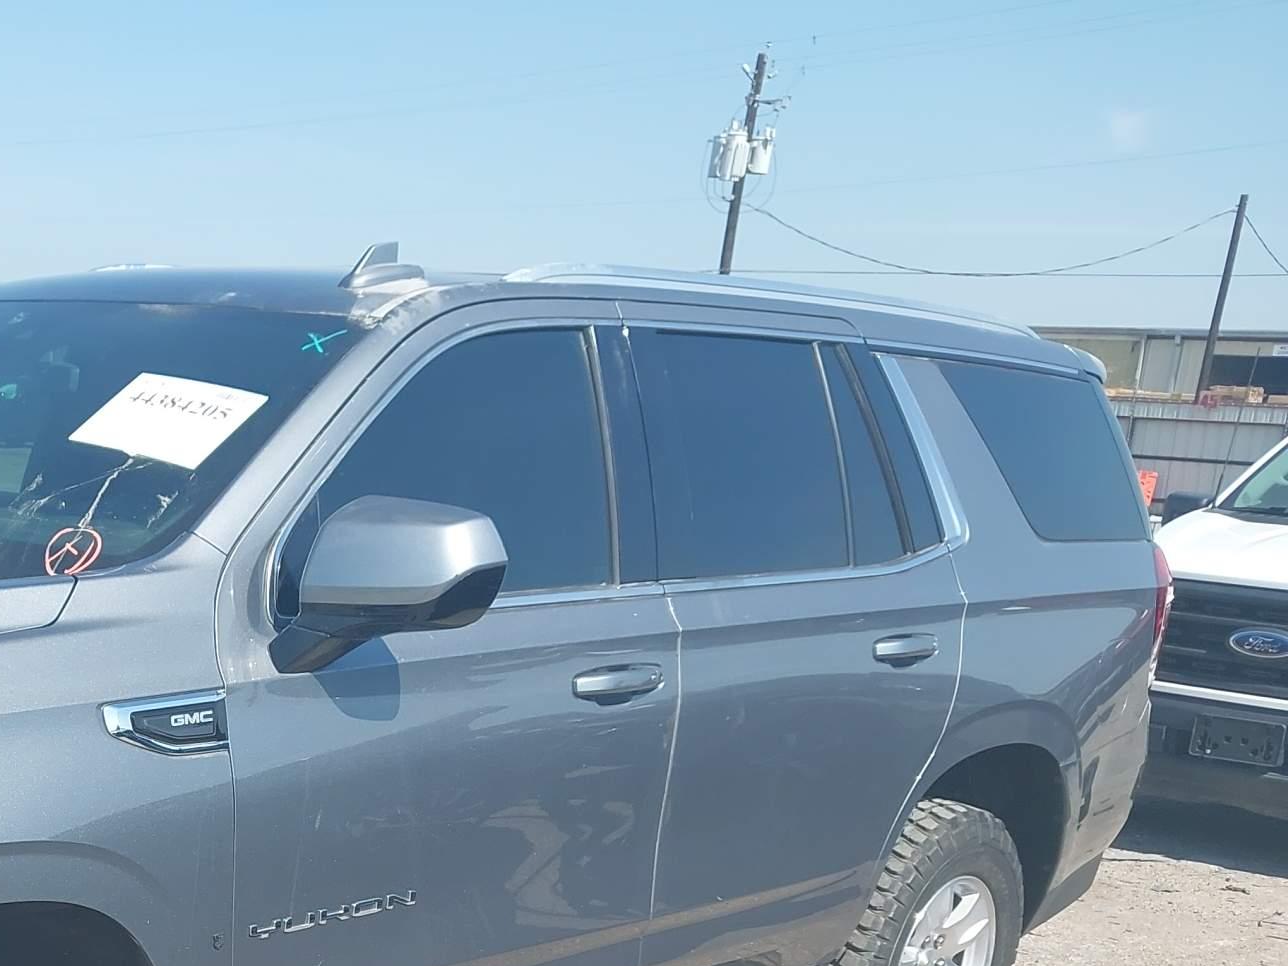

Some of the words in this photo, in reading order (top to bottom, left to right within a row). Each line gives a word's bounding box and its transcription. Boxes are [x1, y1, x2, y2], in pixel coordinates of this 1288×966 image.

[129, 391, 232, 419] 44384205
[1244, 636, 1281, 652] Ford
[171, 711, 213, 727] GMC
[248, 890, 417, 938] YUKON
